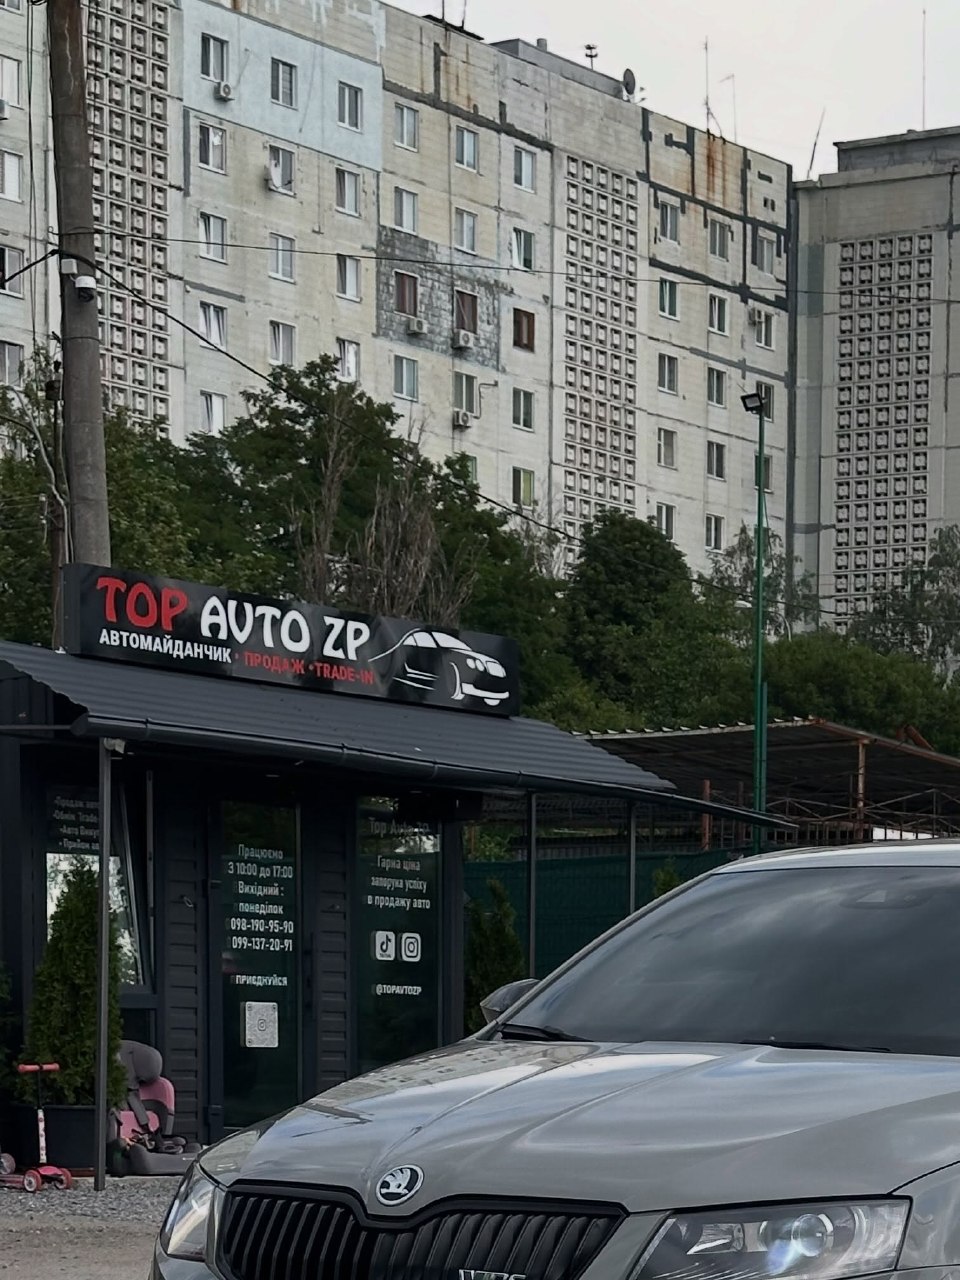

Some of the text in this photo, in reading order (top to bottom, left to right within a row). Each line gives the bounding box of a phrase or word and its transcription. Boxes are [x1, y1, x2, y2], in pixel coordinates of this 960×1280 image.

[96, 576, 370, 660] TOP AVTO ZP
[99, 628, 374, 685] АВТОМАЙДАНЧИК ПРОДАЖ TRADE-IN
[238, 844, 284, 860] Працюємо
[236, 862, 257, 875] 10:00
[259, 866, 271, 878] до
[239, 901, 284, 915] понеділок
[374, 895, 411, 911] продажу
[412, 898, 431, 909] авто
[230, 917, 294, 934] 098-190-95-90
[232, 936, 293, 952] 099-137-20-91
[376, 983, 422, 996] @TOPAVTOZP
